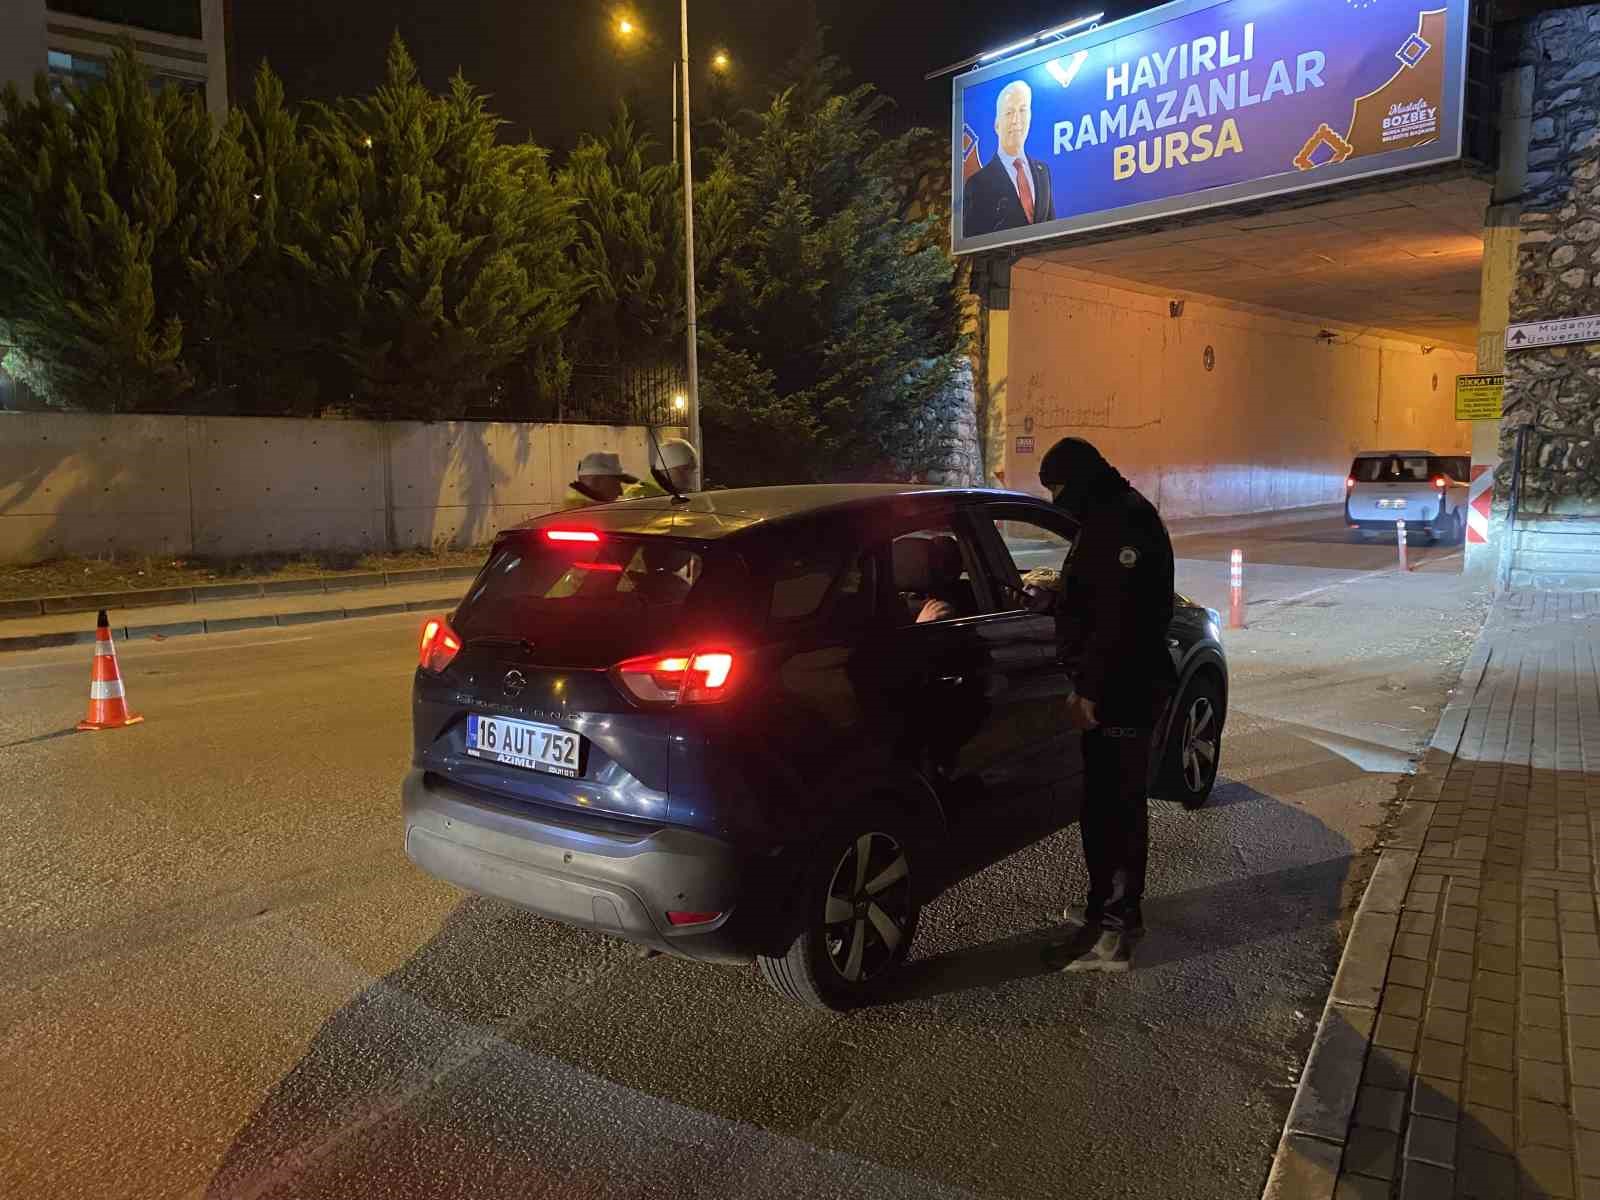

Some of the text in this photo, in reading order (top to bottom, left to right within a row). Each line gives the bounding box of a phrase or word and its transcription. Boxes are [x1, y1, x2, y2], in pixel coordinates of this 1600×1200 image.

[1106, 23, 1254, 100] HAYIRLI
[1053, 50, 1325, 155] RAMAZANLAR
[1382, 107, 1437, 128] BOZBEY
[1113, 118, 1243, 181] BURSA
[480, 720, 575, 765] 16 AUT 752
